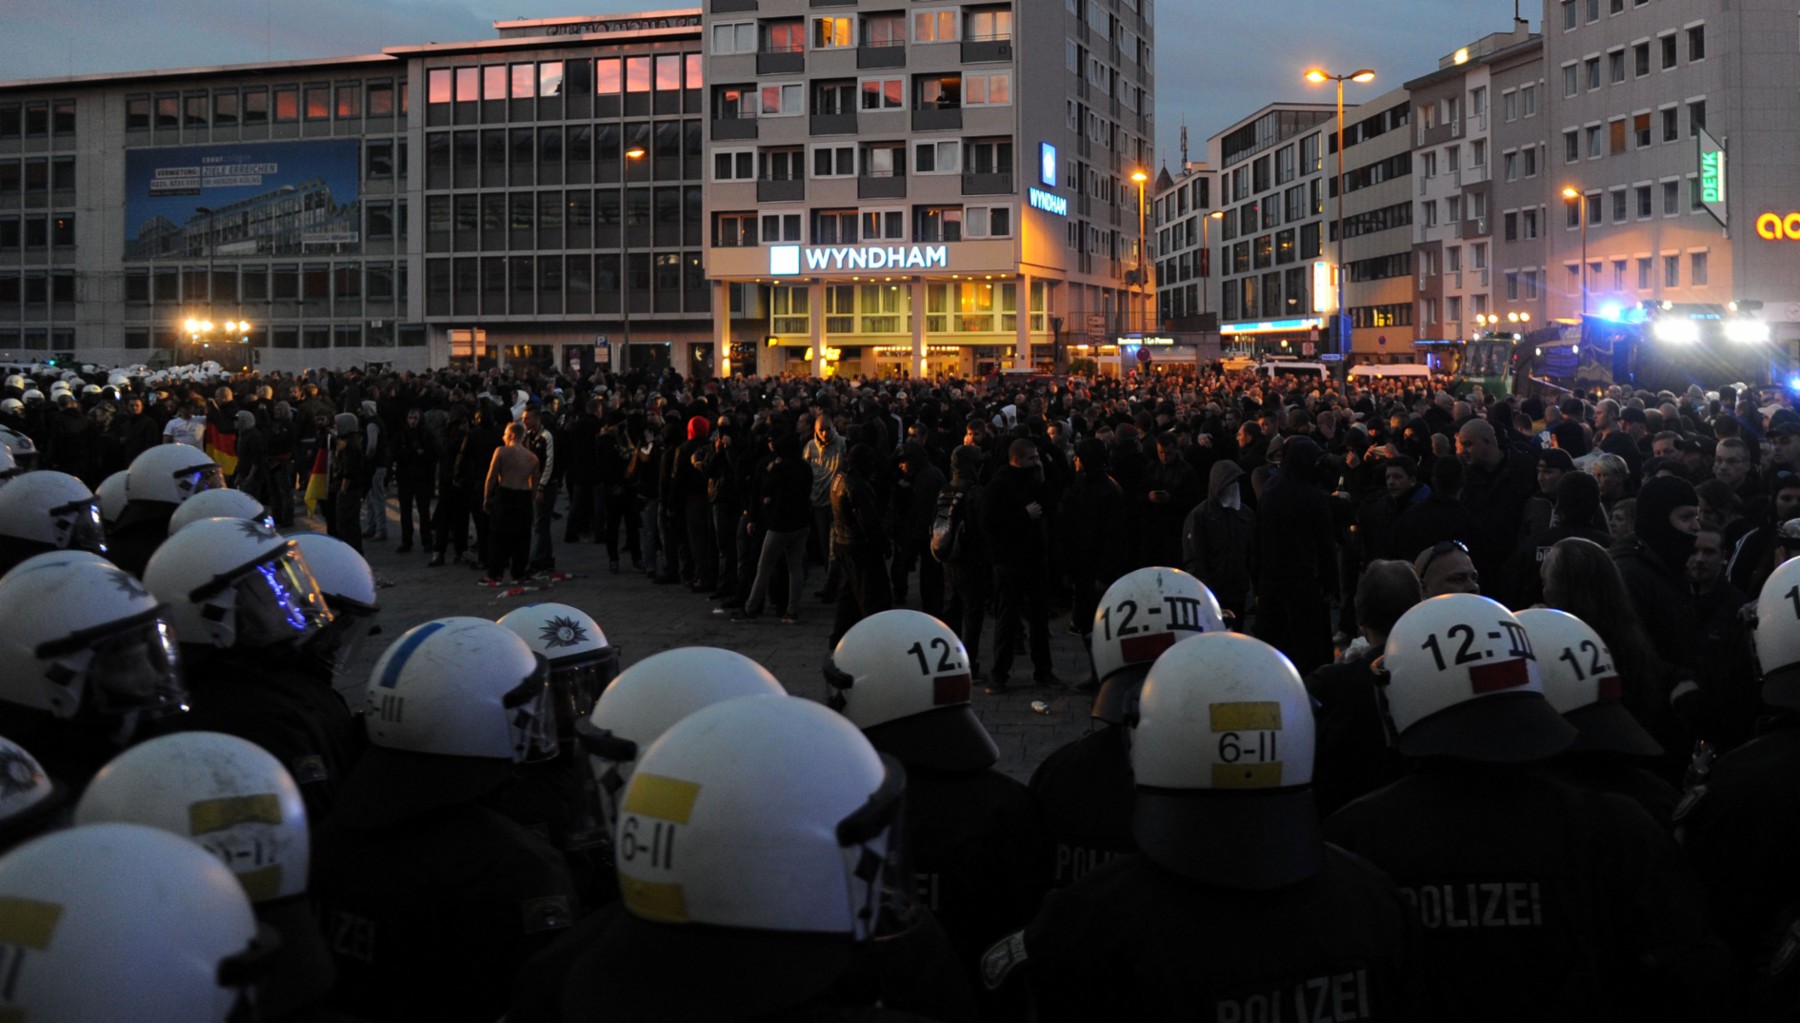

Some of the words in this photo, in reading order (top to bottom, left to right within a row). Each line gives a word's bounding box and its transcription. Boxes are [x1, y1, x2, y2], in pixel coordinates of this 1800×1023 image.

[1702, 151, 1718, 202] DEVK
[1029, 187, 1067, 216] WYNDHAM
[805, 245, 947, 270] WYNDHAM
[1219, 732, 1276, 763] 6-II
[621, 817, 675, 869] 6-II
